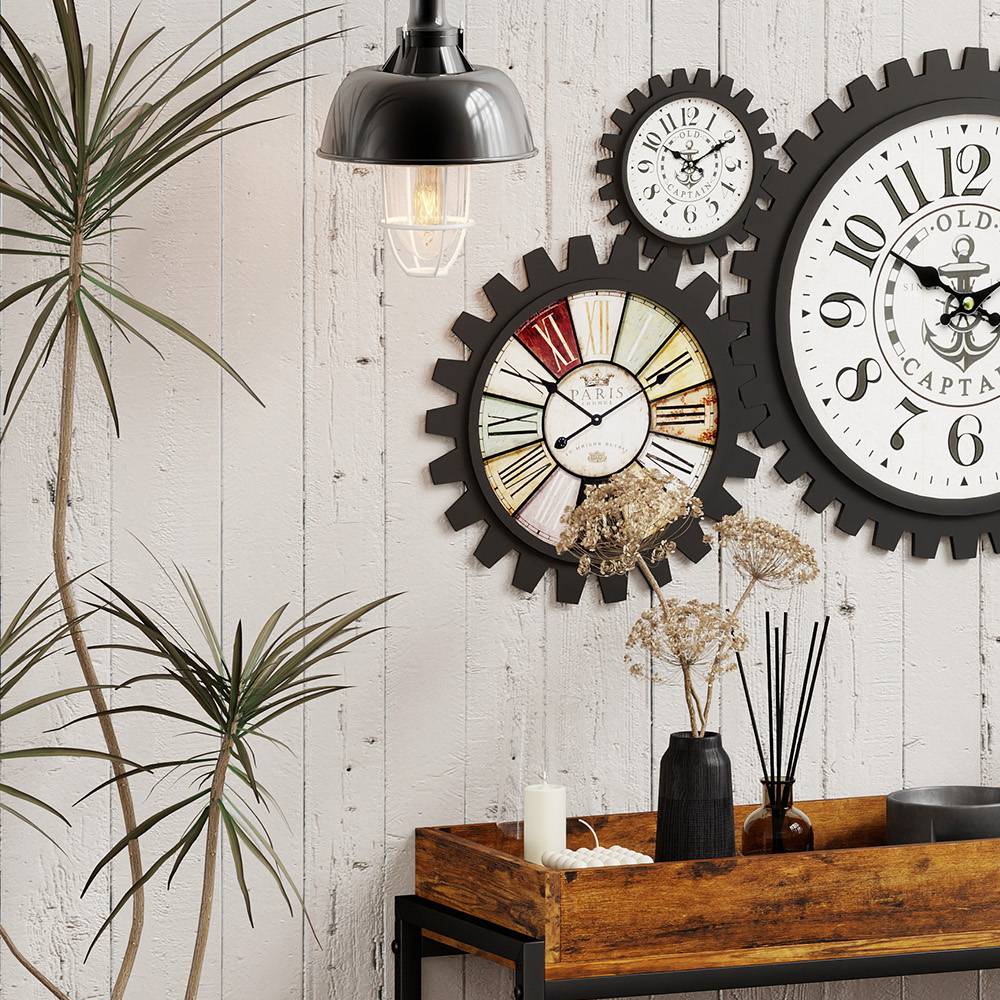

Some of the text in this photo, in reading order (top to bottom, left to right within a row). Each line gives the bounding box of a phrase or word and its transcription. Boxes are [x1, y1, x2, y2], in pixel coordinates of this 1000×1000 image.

[659, 113, 677, 135] 11
[680, 106, 700, 126] 12
[705, 113, 717, 131] 1
[642, 131, 662, 153] 10
[679, 130, 700, 139] OLD
[718, 130, 736, 148] 2
[637, 159, 654, 174] 9
[724, 155, 742, 172] 3
[936, 144, 992, 199] 12
[642, 183, 661, 200] 8
[667, 182, 712, 199] CAPTAIN
[720, 181, 736, 199] 4
[875, 160, 934, 225] 11
[662, 198, 676, 218] 7
[683, 204, 697, 224] 6
[705, 197, 719, 217] 5
[935, 209, 993, 233] OLD
[829, 214, 886, 276] 10
[819, 291, 867, 328] 9
[585, 300, 610, 355] XII
[531, 312, 578, 374] XI
[835, 357, 882, 402] 8
[570, 386, 624, 401] PARIS
[487, 412, 539, 437] IX
[655, 403, 706, 427] III
[890, 396, 929, 451] 7
[948, 414, 984, 467] 6
[498, 443, 553, 498] VIII
